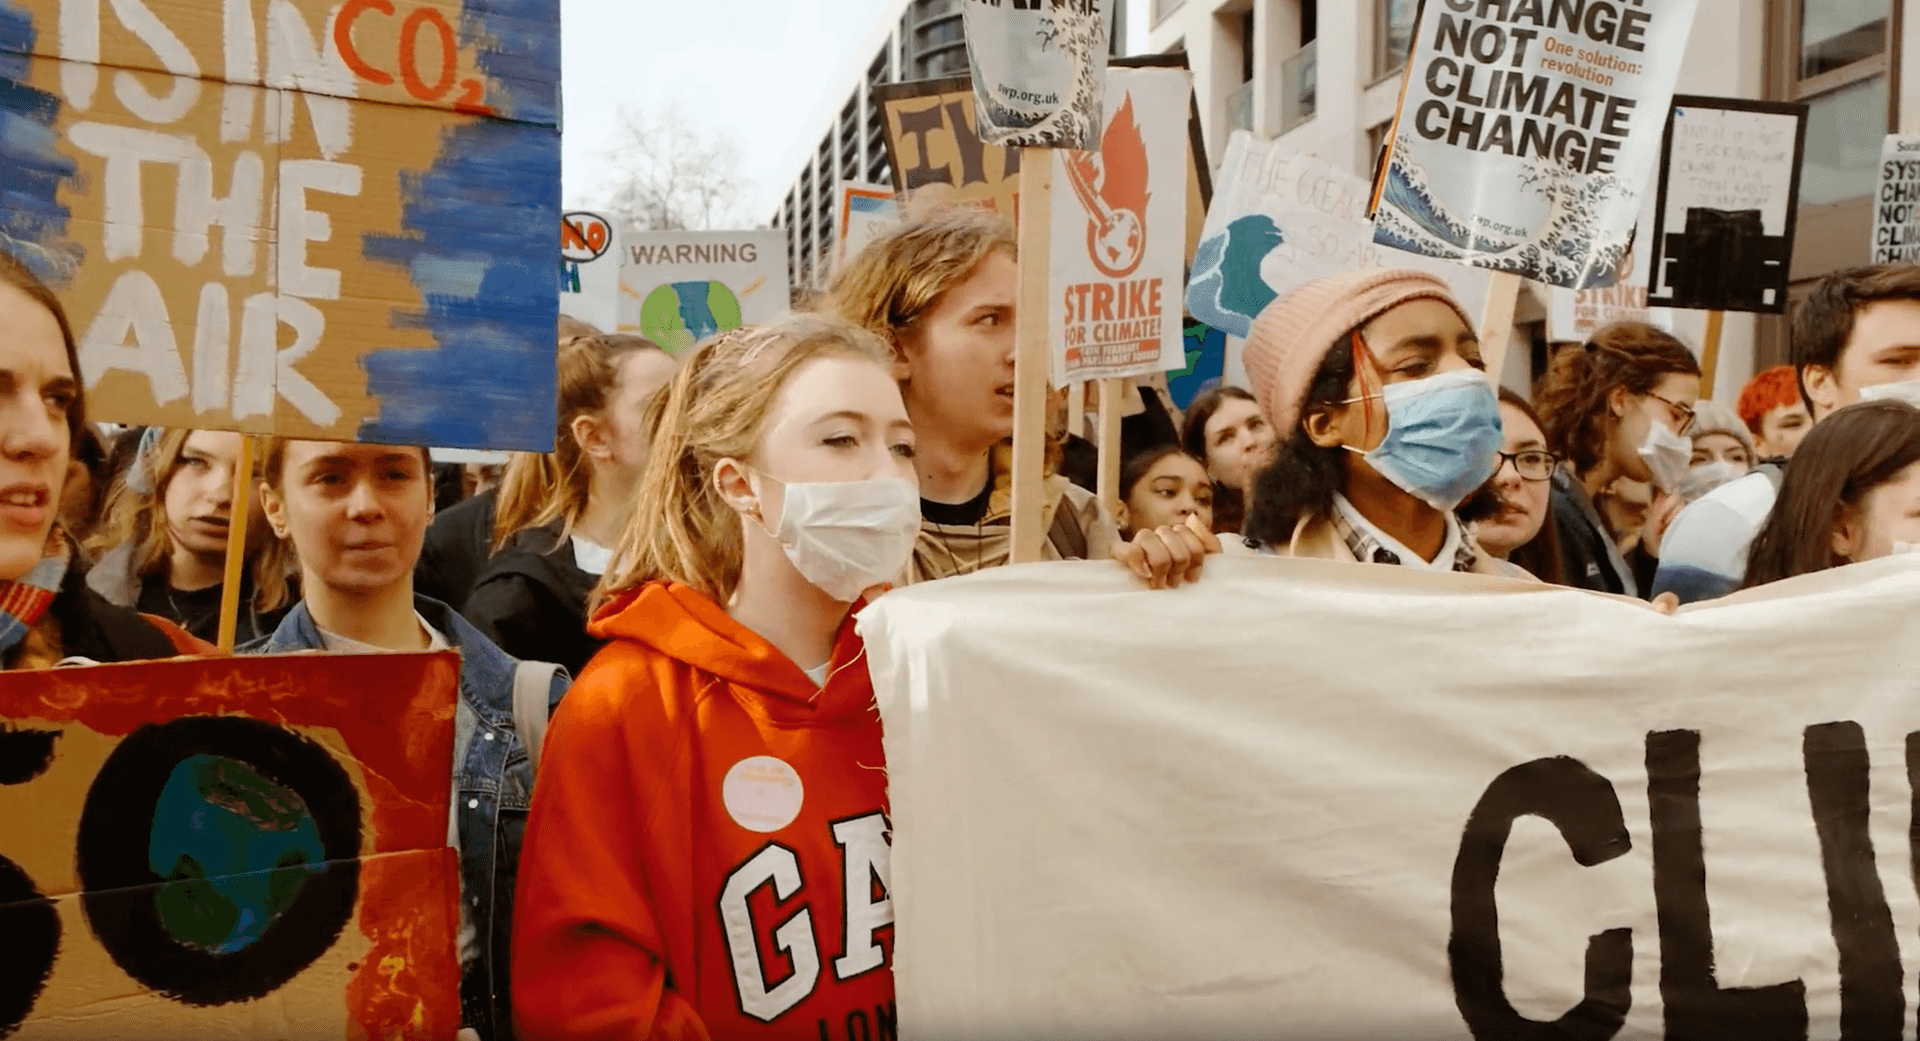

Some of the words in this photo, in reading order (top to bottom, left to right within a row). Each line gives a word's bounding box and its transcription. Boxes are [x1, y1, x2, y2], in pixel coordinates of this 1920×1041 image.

[1433, 12, 1538, 67] NOT
[1543, 36, 1573, 57] One
[1577, 48, 1643, 75] solution:
[1540, 56, 1614, 87] revolution
[1425, 56, 1637, 137] CLIMATE
[1415, 99, 1622, 175] CHANGE
[67, 121, 362, 299] THE
[1879, 204, 1913, 224] NOT
[561, 219, 605, 250] NO
[631, 242, 758, 265] WARNING
[1064, 278, 1163, 325] STRIKE
[78, 270, 342, 427] AIR
[1093, 317, 1162, 344] CLIMATE!
[1449, 720, 1920, 1041] CLI
